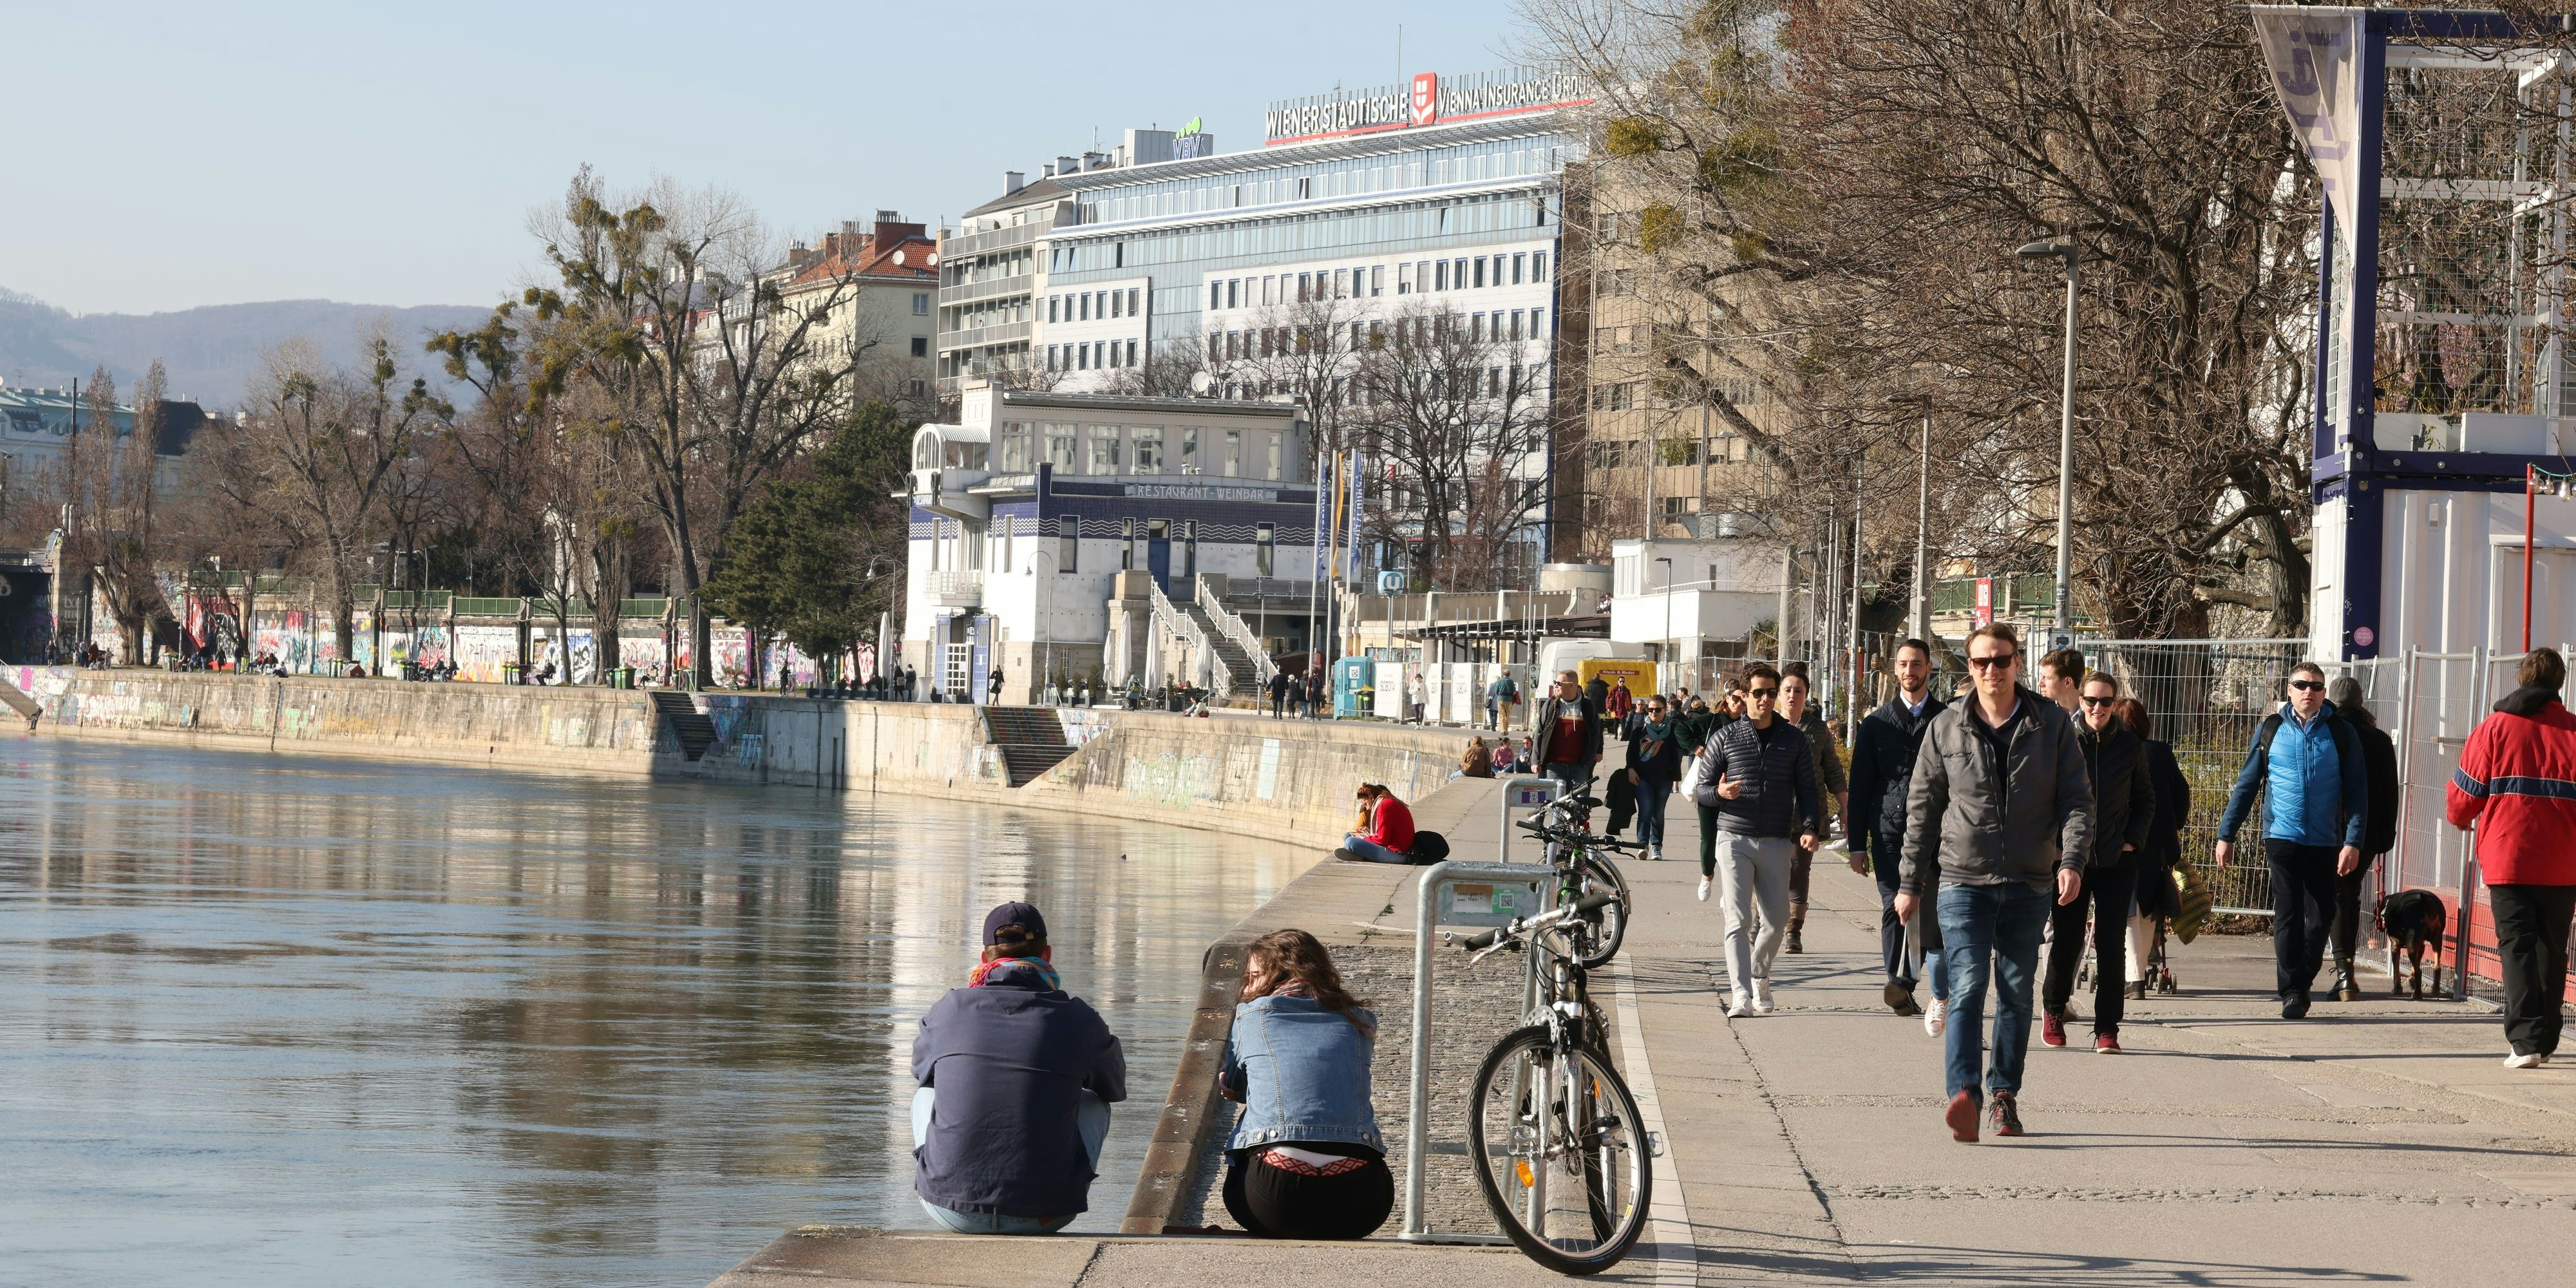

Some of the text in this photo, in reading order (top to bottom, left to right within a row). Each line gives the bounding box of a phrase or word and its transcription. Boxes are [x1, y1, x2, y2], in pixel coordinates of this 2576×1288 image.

[1439, 87, 1481, 113] VIENNA
[1482, 79, 1550, 107] INSURANCE
[1266, 93, 1409, 137] WIENER STÄDTISCHE
[1173, 136, 1200, 160] VBV
[1137, 485, 1209, 499] RESTAURANT
[1217, 488, 1264, 500] WEINBAR
[1387, 576, 1401, 590] U
